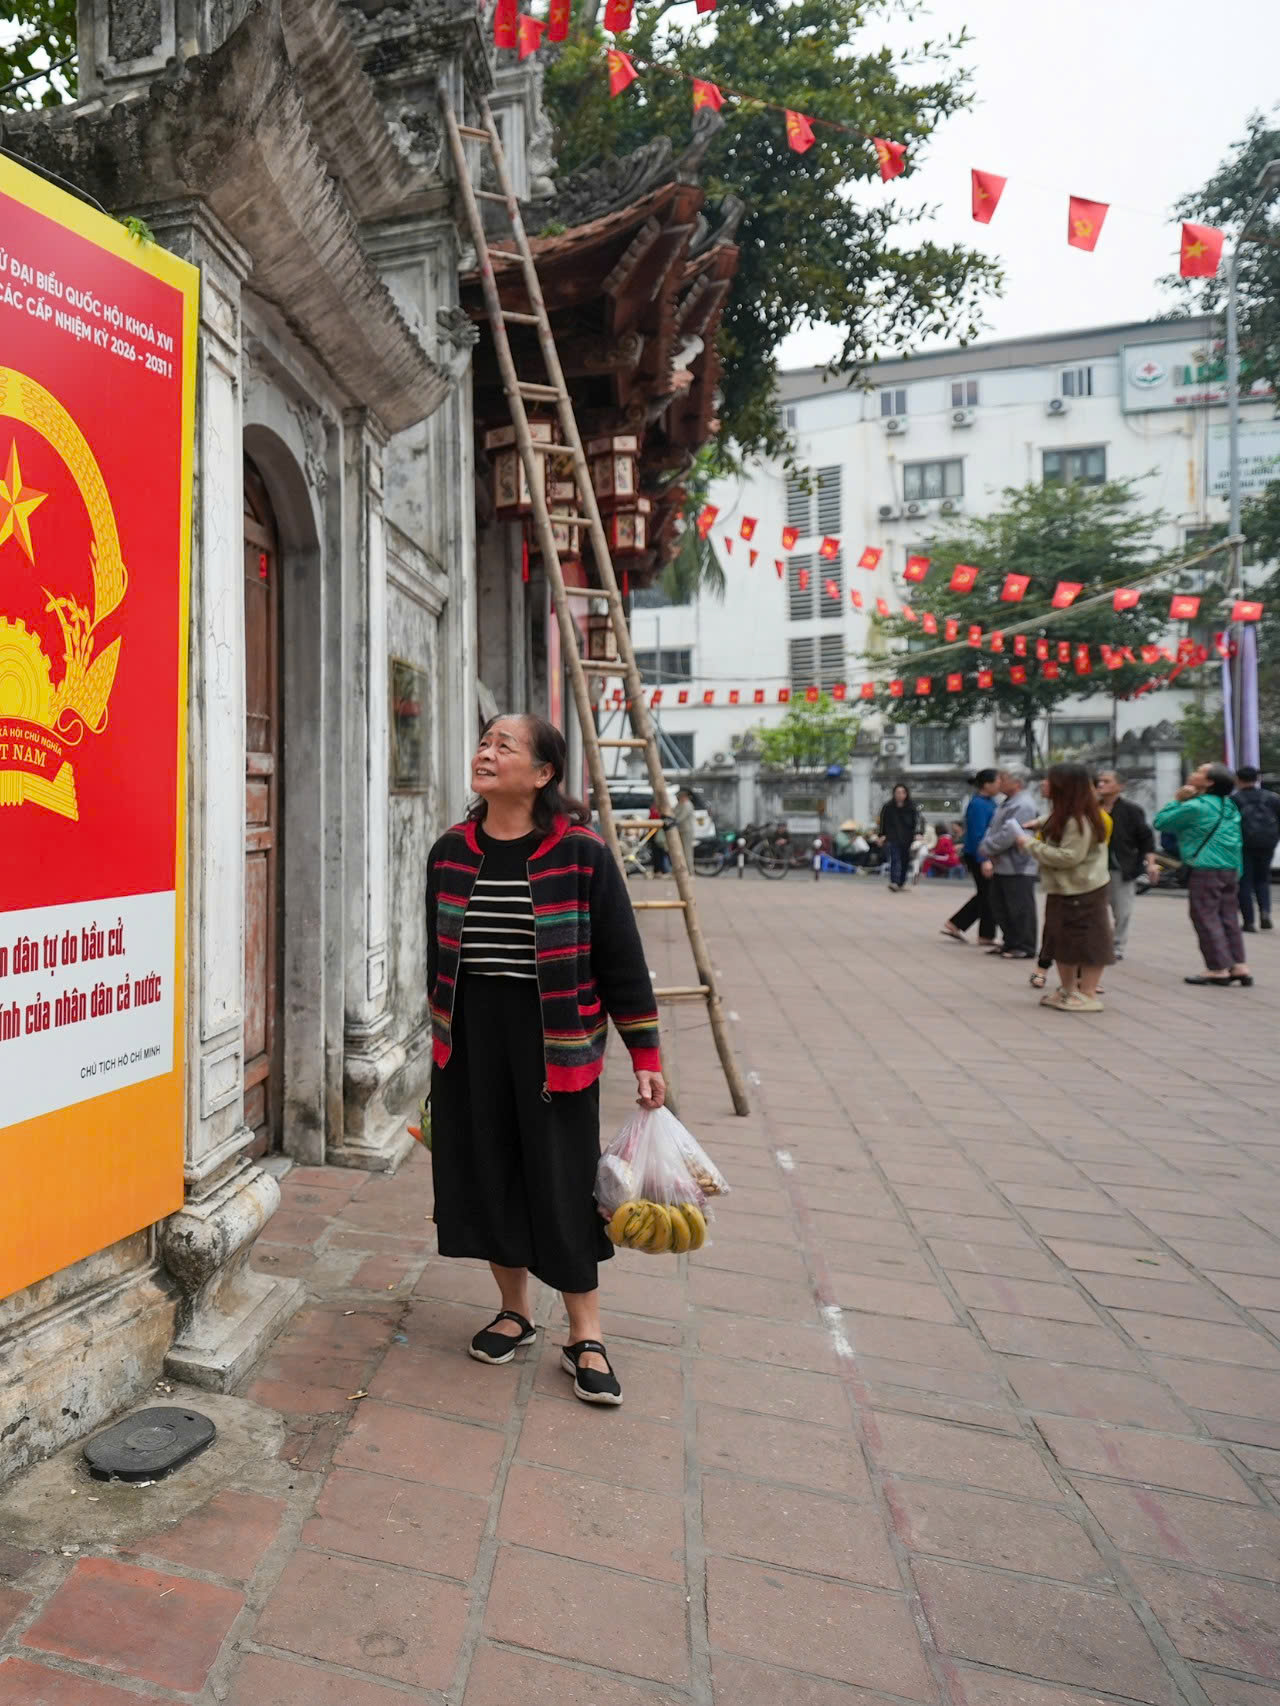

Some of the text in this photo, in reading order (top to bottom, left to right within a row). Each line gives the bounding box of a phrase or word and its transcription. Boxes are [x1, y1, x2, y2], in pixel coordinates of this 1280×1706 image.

[10, 258, 34, 287] ĐẠI
[36, 271, 63, 299] BIỂU
[65, 287, 102, 317] QUỐC
[104, 304, 123, 330] HỘI
[156, 332, 173, 353] XVI
[26, 295, 53, 322] CẤP
[55, 310, 92, 341] NHIỆM
[94, 328, 109, 350] KỲ
[111, 336, 136, 361] 2026
[13, 744, 47, 767] NAM
[13, 936, 39, 976] dân
[43, 933, 58, 977] tự
[61, 929, 78, 965] do
[81, 921, 104, 962] bầu
[25, 992, 51, 1036] của
[54, 987, 87, 1028] nhân
[90, 982, 113, 1019] dân
[117, 973, 131, 1012] cả
[133, 971, 162, 1008] nước
[144, 1045, 161, 1059] MINH
